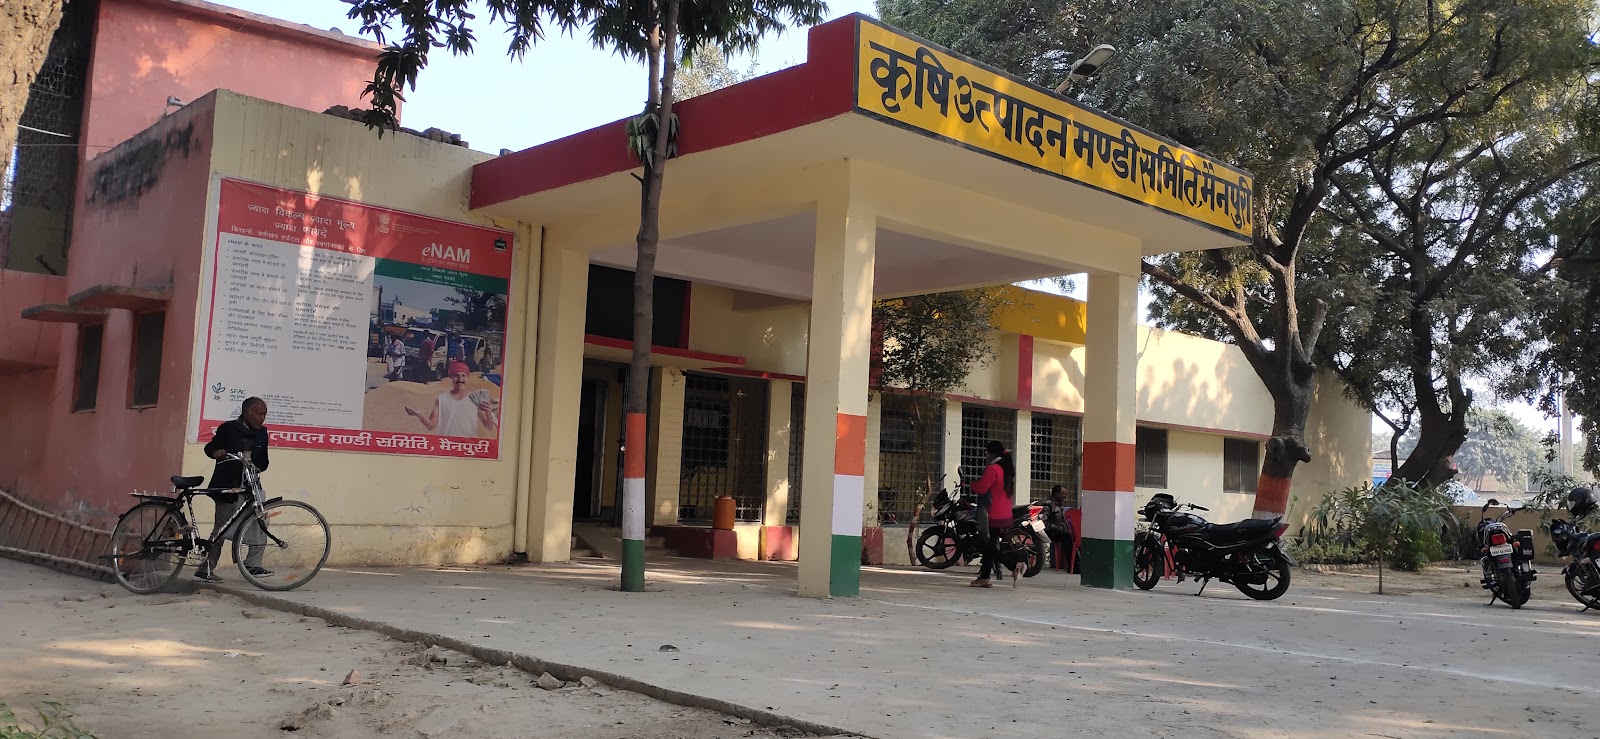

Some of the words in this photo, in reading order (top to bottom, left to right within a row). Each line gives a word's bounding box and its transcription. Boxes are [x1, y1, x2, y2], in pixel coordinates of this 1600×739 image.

[869, 40, 953, 118] कृषि
[954, 75, 1072, 160] उत्पादन
[1072, 128, 1141, 184] मण्डी
[1201, 160, 1252, 230] मैनपुरी
[247, 203, 269, 215] ज्यादा
[275, 205, 305, 221] विकल्प
[310, 215, 332, 226] ज्यादा
[336, 219, 356, 231] मूल्य
[274, 222, 297, 233] ज्यादा
[302, 225, 328, 239] फायदे
[302, 237, 314, 245] और
[356, 246, 367, 255] लिए
[421, 242, 471, 264] eNAM
[267, 430, 325, 445] त्पादन
[329, 432, 371, 446] मण्डी
[376, 435, 435, 452] समिति,
[439, 437, 491, 456] मैनपुरी
